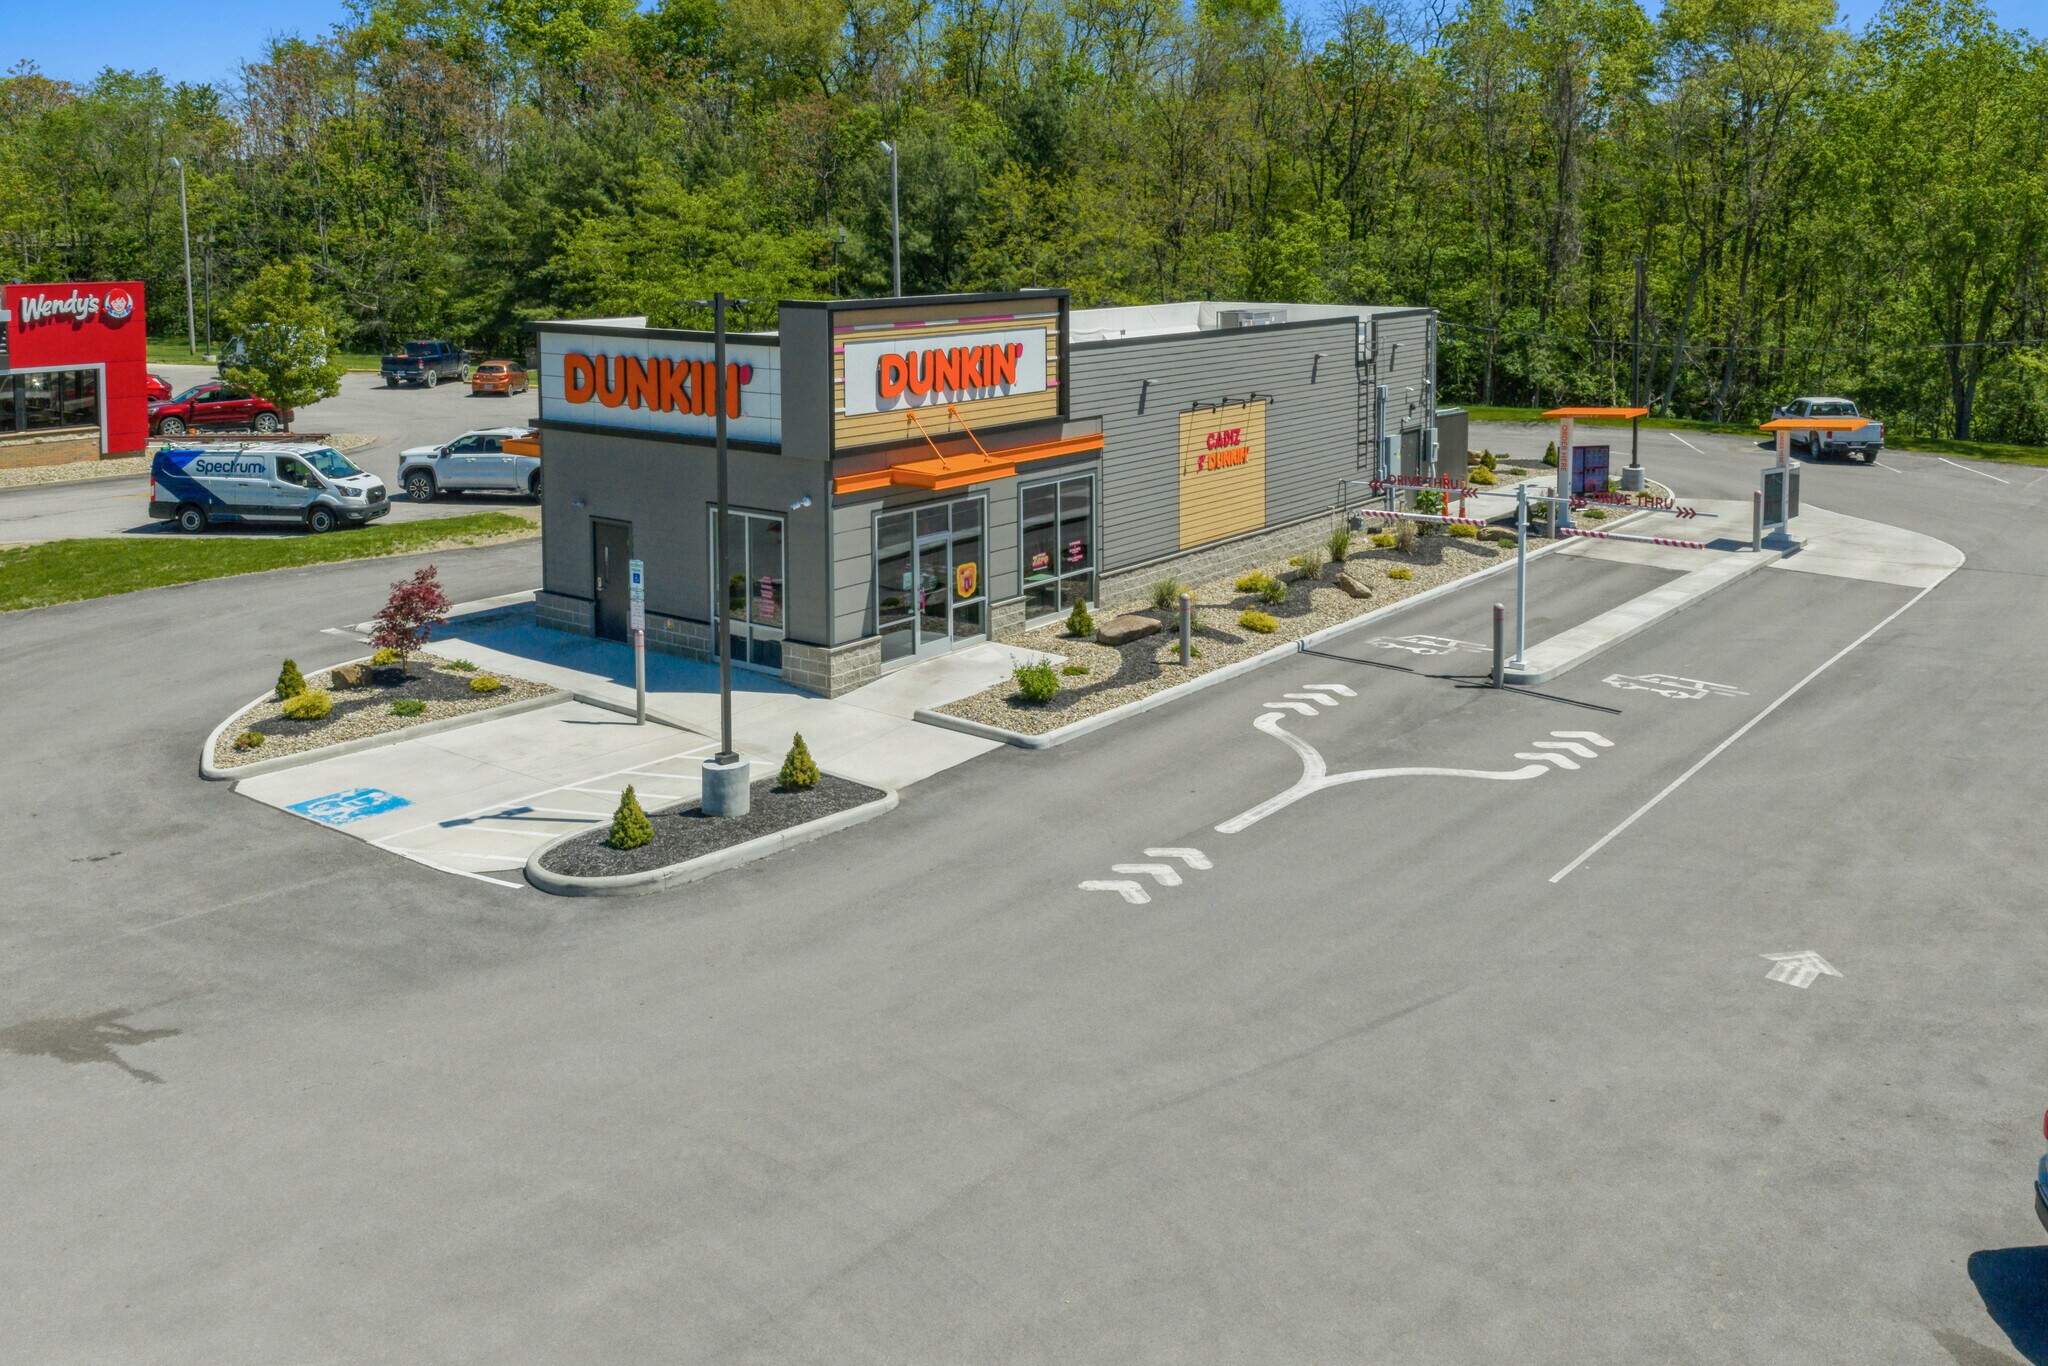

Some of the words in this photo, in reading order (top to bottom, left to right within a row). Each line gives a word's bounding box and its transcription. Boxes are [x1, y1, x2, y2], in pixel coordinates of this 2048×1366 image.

[21, 289, 100, 323] Wendy's
[880, 342, 1023, 398] DUNKIN'
[1206, 427, 1241, 450] CADIZ
[196, 459, 263, 476] Spectrum
[1207, 446, 1249, 472] DUNKIN'
[1560, 453, 1568, 472] HERE
[1388, 474, 1423, 487] DRIVE
[1427, 477, 1459, 490] THRU
[1592, 491, 1632, 506] DRIVE
[1636, 494, 1674, 510] THRU
